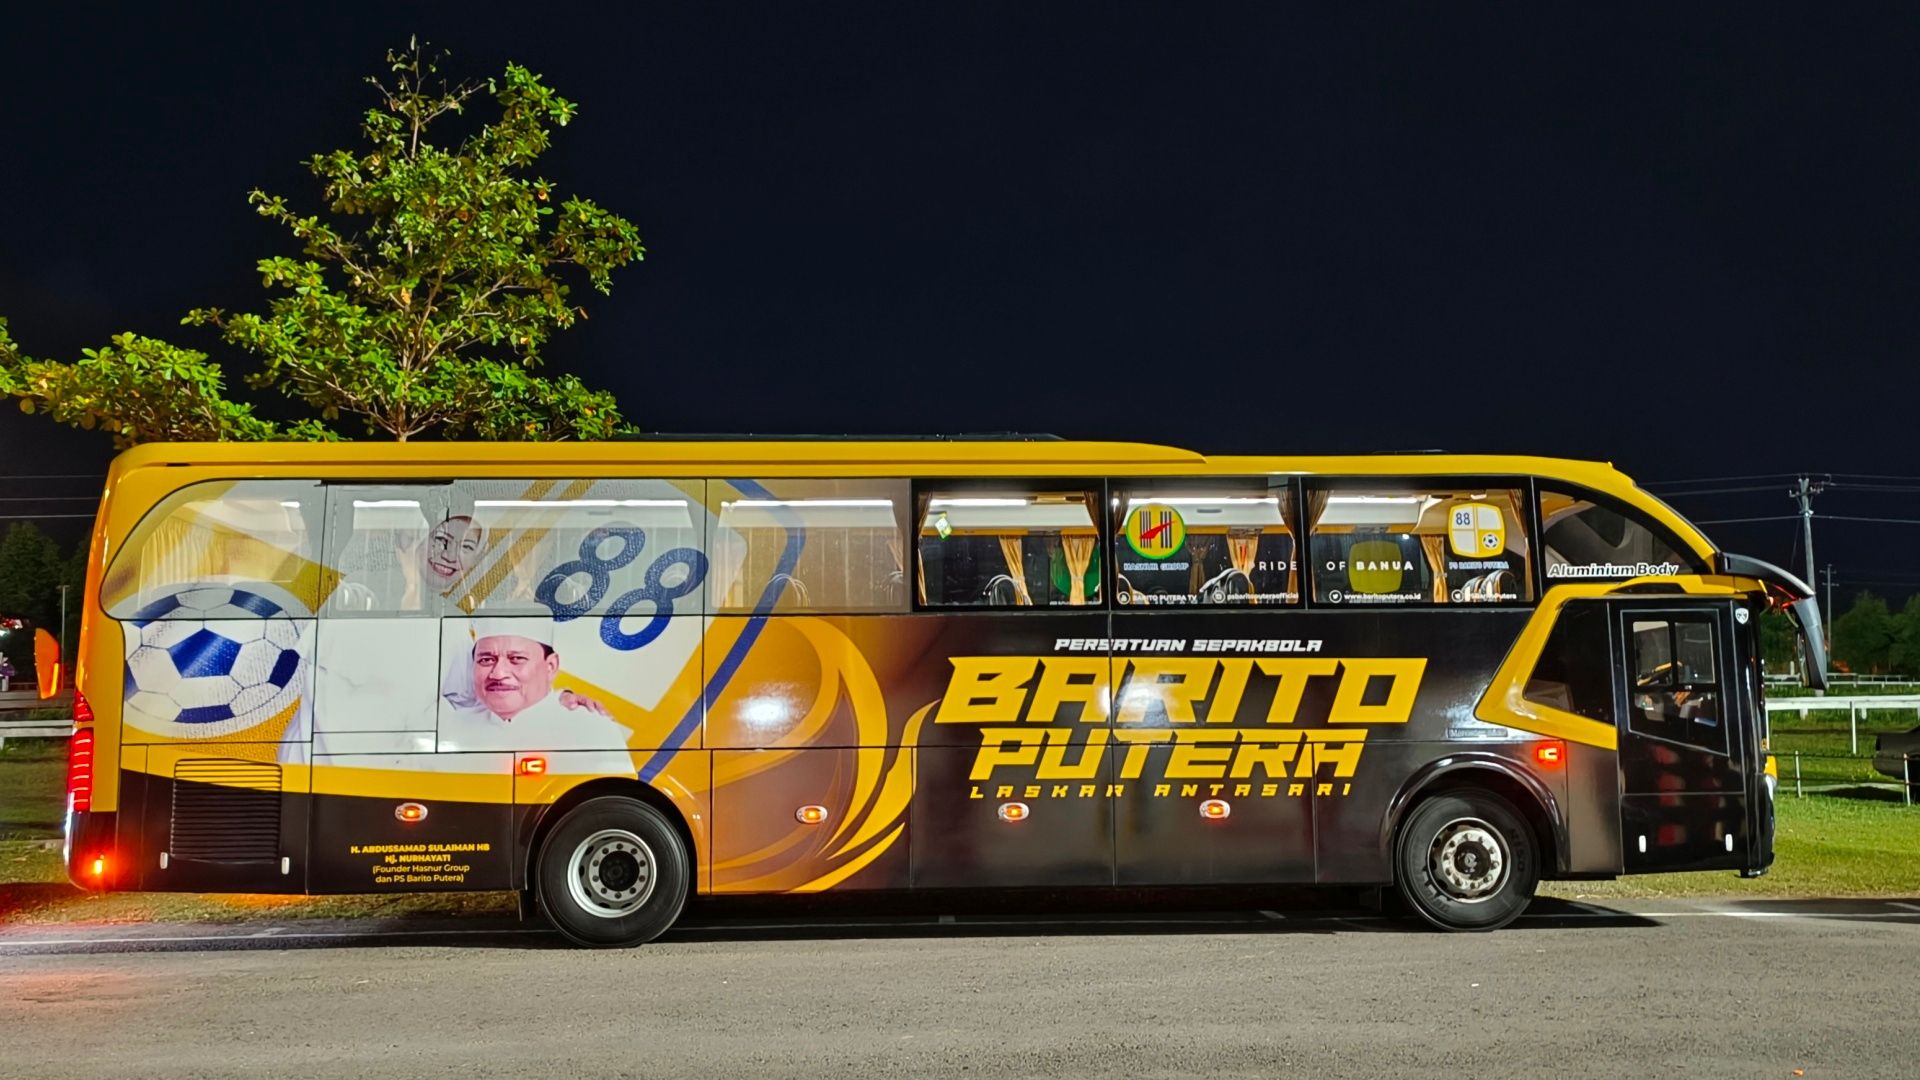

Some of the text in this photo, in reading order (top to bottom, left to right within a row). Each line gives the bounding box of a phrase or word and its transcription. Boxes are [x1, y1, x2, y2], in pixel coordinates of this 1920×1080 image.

[1455, 512, 1471, 526] 88
[1159, 562, 1189, 571] GROUP
[1326, 561, 1346, 571] OF
[1356, 561, 1414, 571] BANUA
[1482, 561, 1510, 570] PUTERA
[1547, 562, 1679, 578] Aluminium Body
[534, 520, 709, 651] 88
[1054, 639, 1323, 652] PERSATUAN SEPAKBOLA
[934, 656, 1428, 724] BARITO
[968, 728, 1369, 781] PUTERA
[970, 783, 1352, 799] LASKAR ANTASARI
[350, 843, 490, 854] H. ABDUSSAMAD SULAIMAN HB
[398, 853, 451, 862] NURHAYATI
[372, 863, 470, 875] (Founder Hasnur Group
[375, 873, 464, 883] dan PS Barito Putera)
